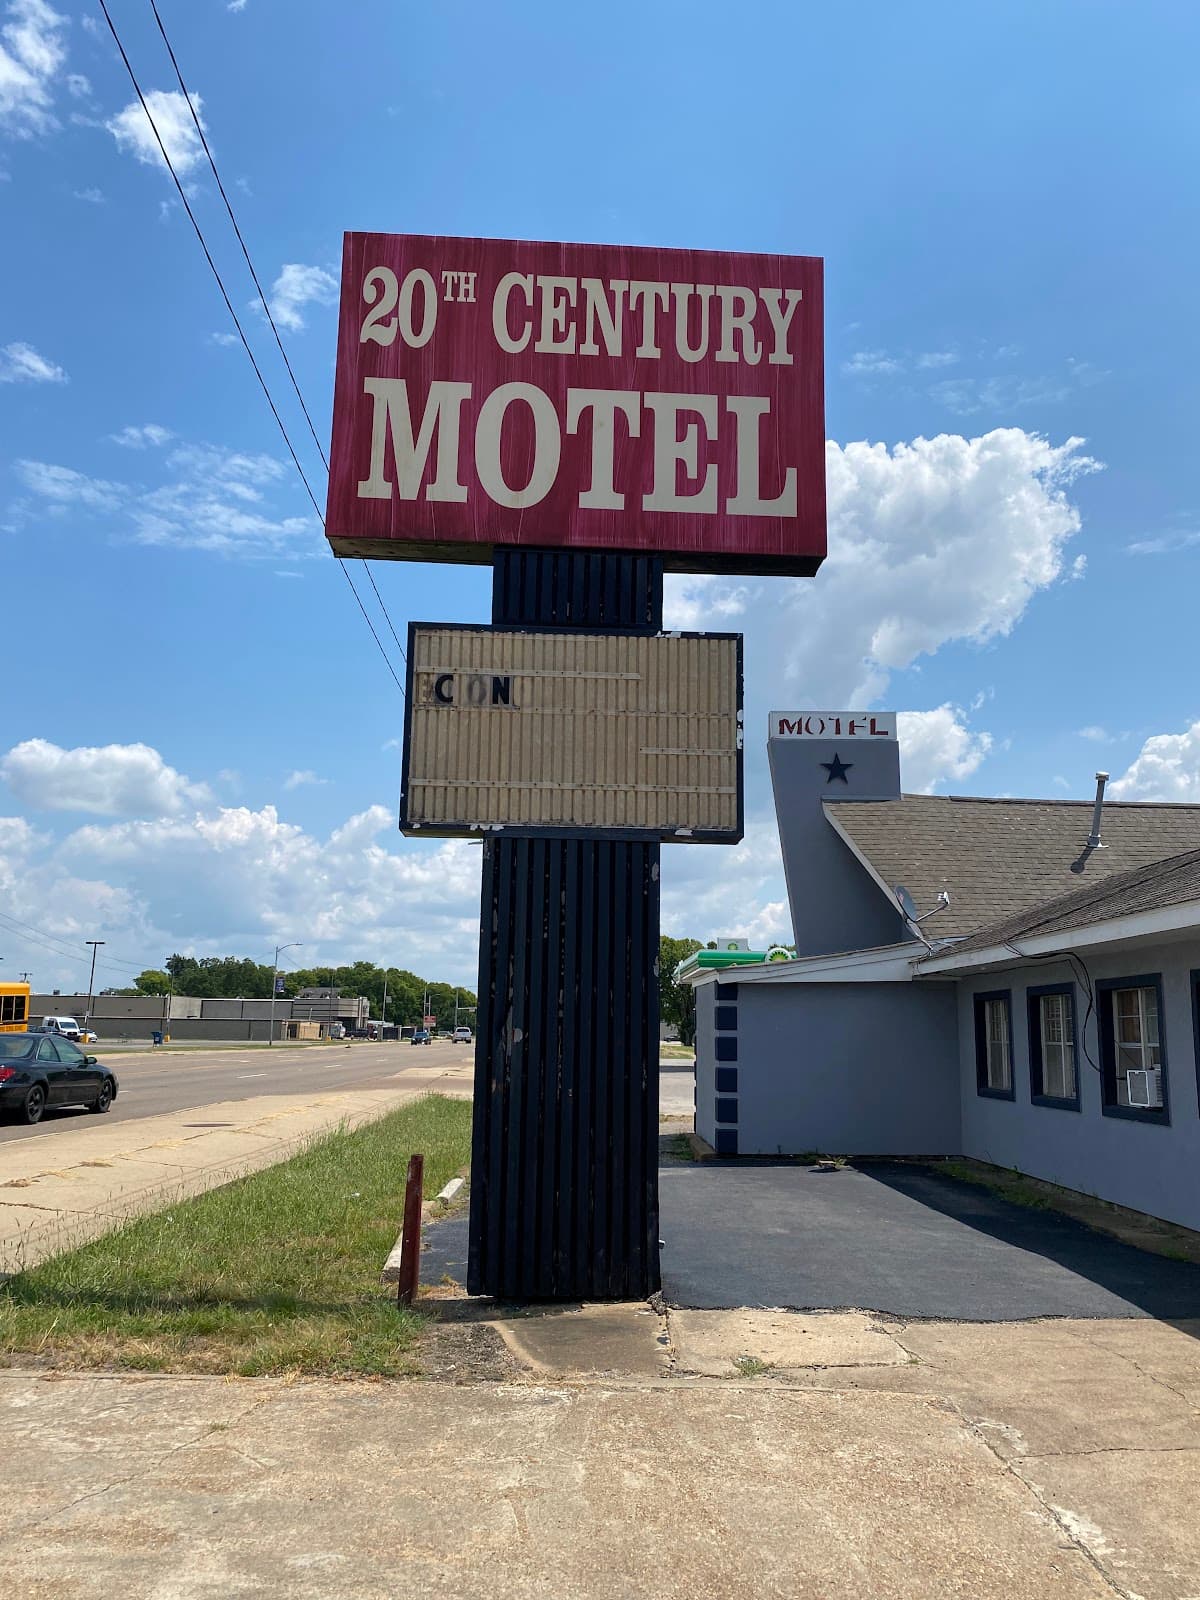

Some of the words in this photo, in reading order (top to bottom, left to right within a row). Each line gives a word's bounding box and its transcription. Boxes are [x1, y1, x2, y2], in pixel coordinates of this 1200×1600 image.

[359, 265, 477, 349] 20TH
[492, 271, 803, 366] CENTURY
[357, 376, 798, 518] MOTEL
